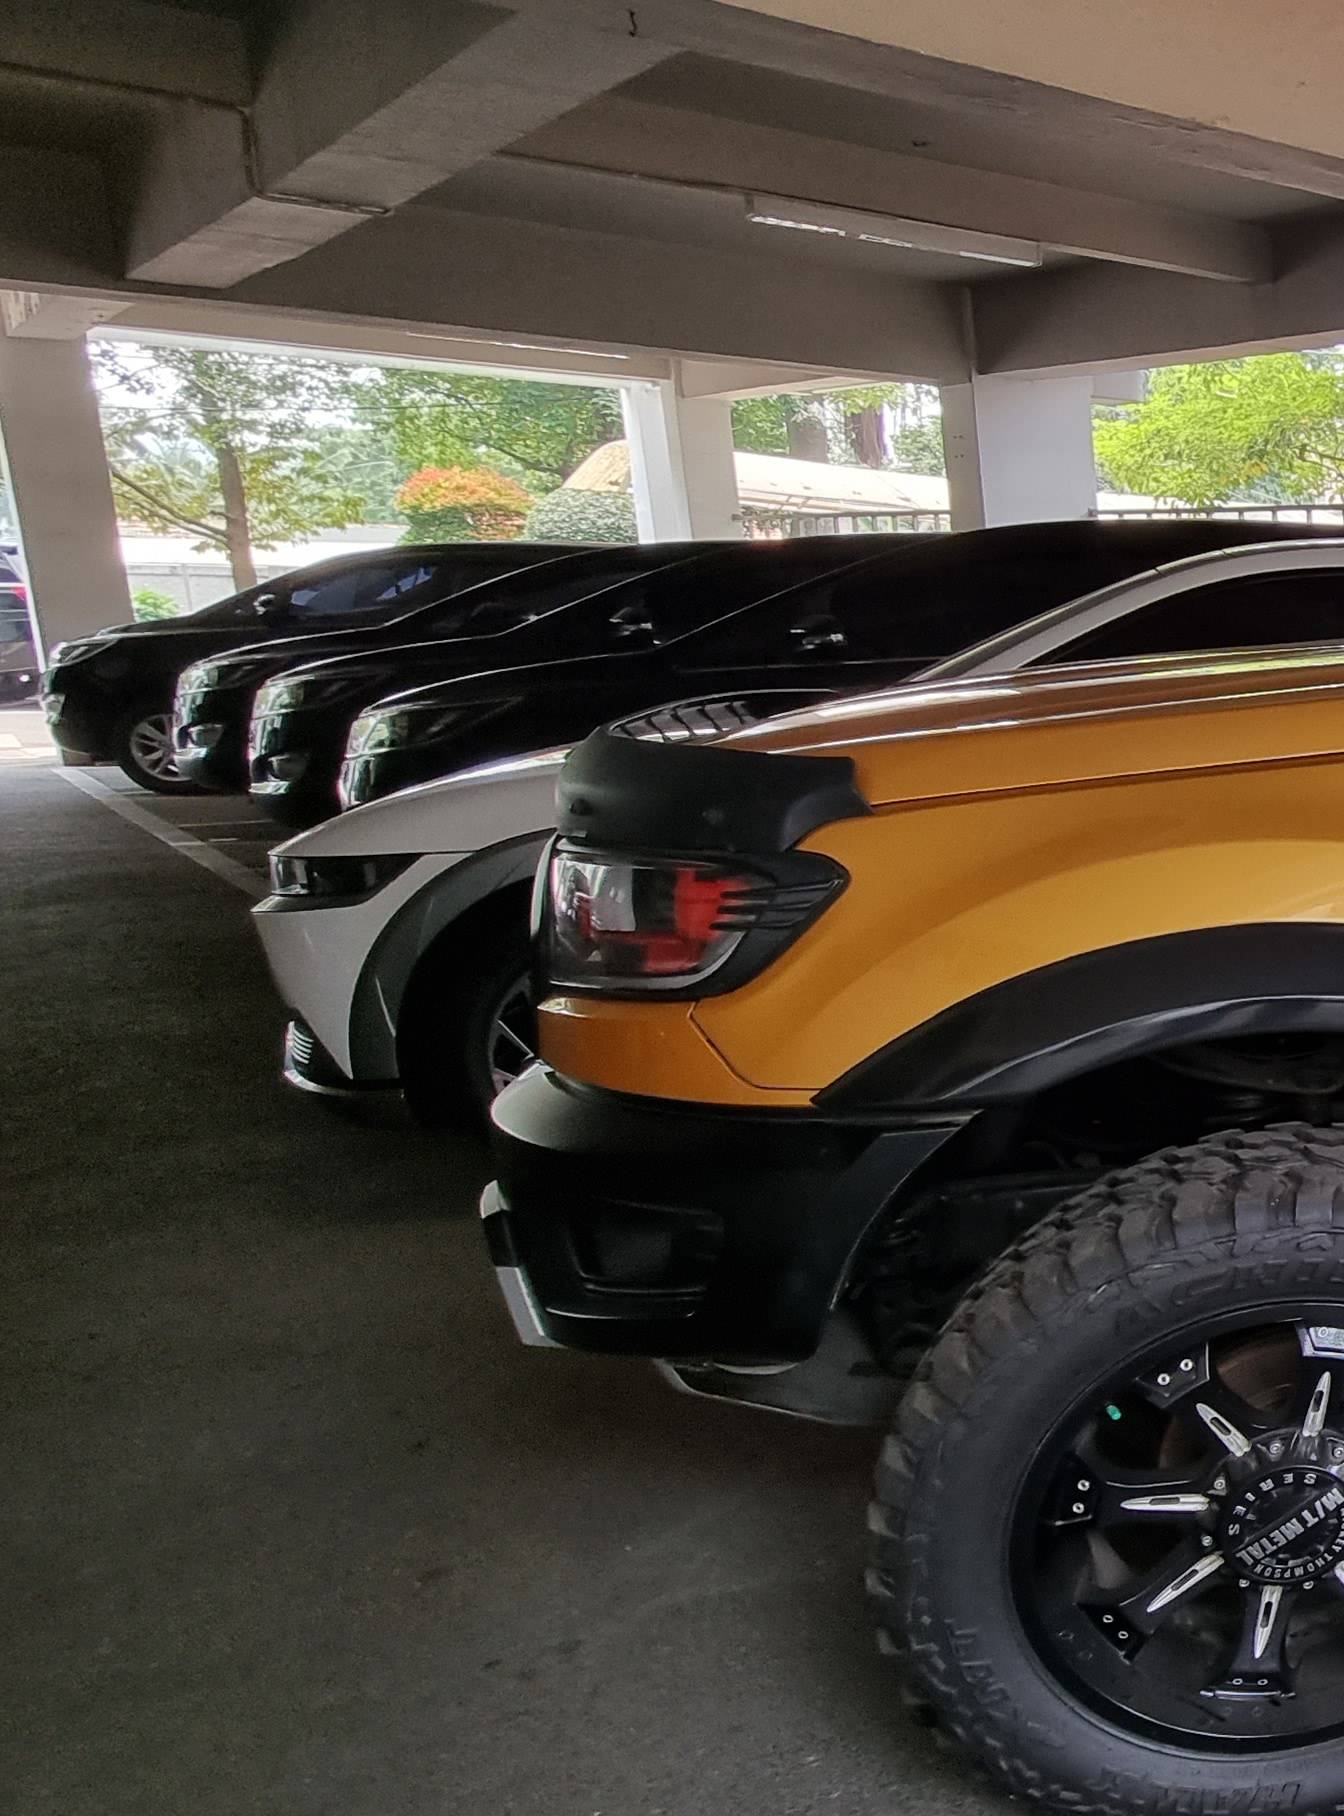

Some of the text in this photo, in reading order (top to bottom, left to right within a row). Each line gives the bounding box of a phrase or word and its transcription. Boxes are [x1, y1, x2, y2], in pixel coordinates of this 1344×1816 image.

[1228, 1472, 1317, 1536] SERIES
[1235, 1517, 1305, 1566] METAL
[1253, 1552, 1334, 1579] THOMPSON
